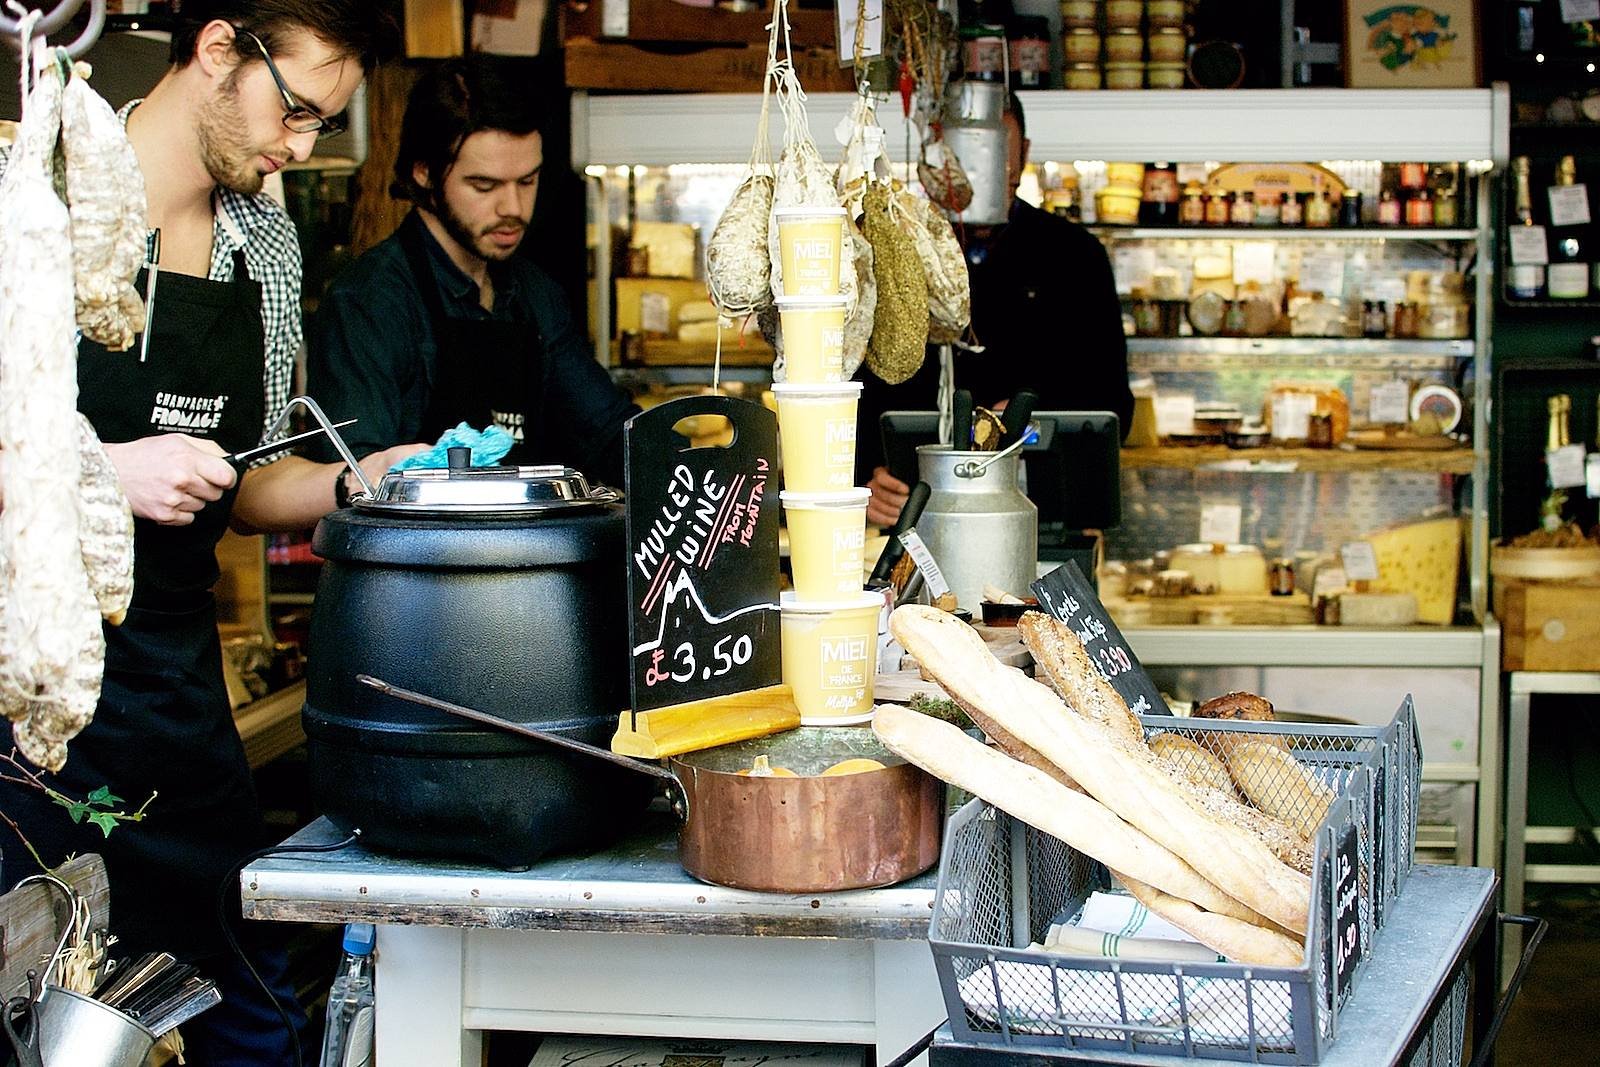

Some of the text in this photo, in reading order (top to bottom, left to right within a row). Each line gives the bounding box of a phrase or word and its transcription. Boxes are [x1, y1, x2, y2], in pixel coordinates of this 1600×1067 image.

[794, 241, 832, 260] MIEL
[156, 392, 214, 412] CHAMPAGNE
[150, 406, 222, 428] FROMAGE
[634, 464, 694, 580] MULLED
[722, 502, 747, 543] FROM
[833, 530, 864, 551] MIE
[645, 634, 753, 687] £3.50
[822, 638, 867, 663] MIEL
[829, 674, 863, 686] FRANCE
[841, 665, 853, 674] DE
